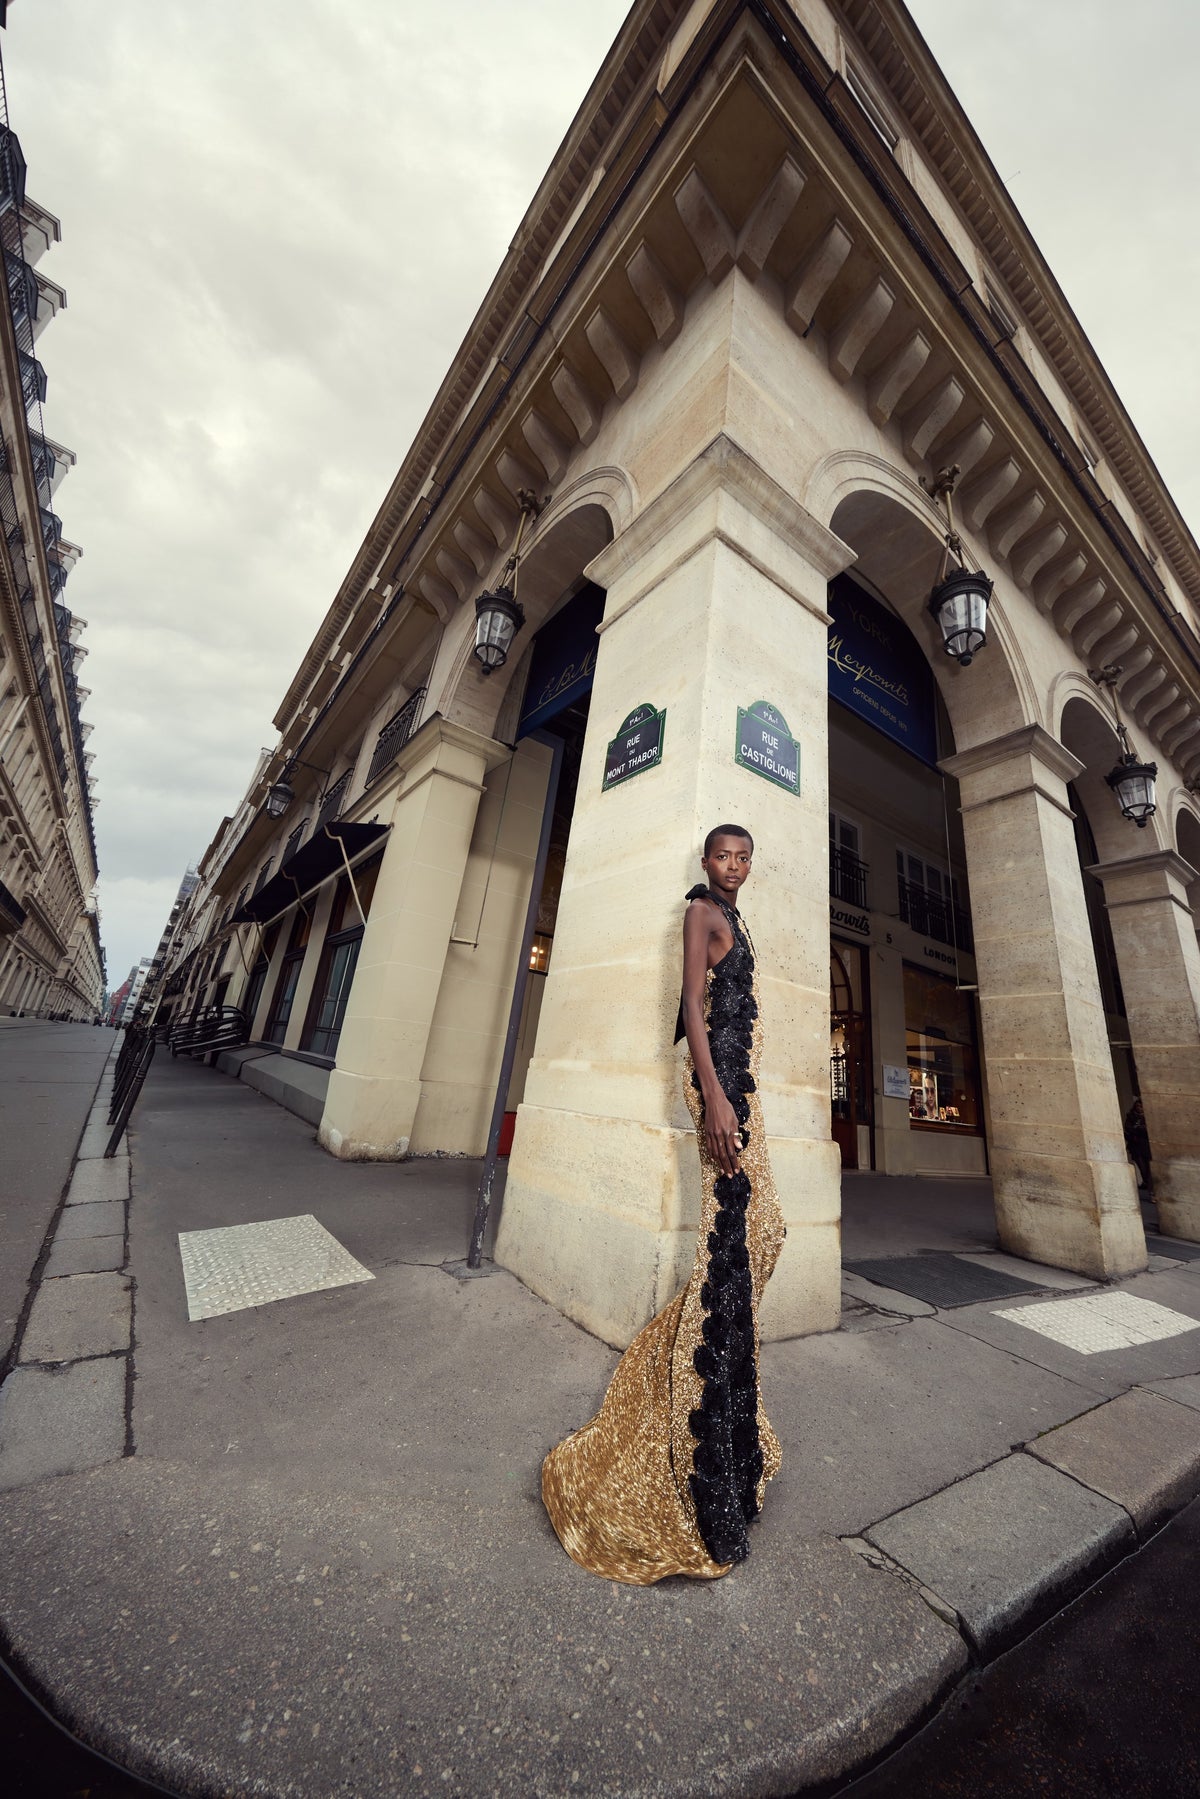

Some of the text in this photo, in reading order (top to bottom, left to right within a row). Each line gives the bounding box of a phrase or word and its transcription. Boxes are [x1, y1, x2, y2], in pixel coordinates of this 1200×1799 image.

[827, 634, 909, 704] Meyrowitz
[626, 733, 641, 749] RUE
[761, 731, 779, 750] RUE
[766, 747, 774, 757] DE
[606, 746, 658, 780] MONT THABOR
[740, 744, 797, 784] CASTIGLIONE
[830, 905, 870, 935] rowitz
[886, 933, 893, 944] 5
